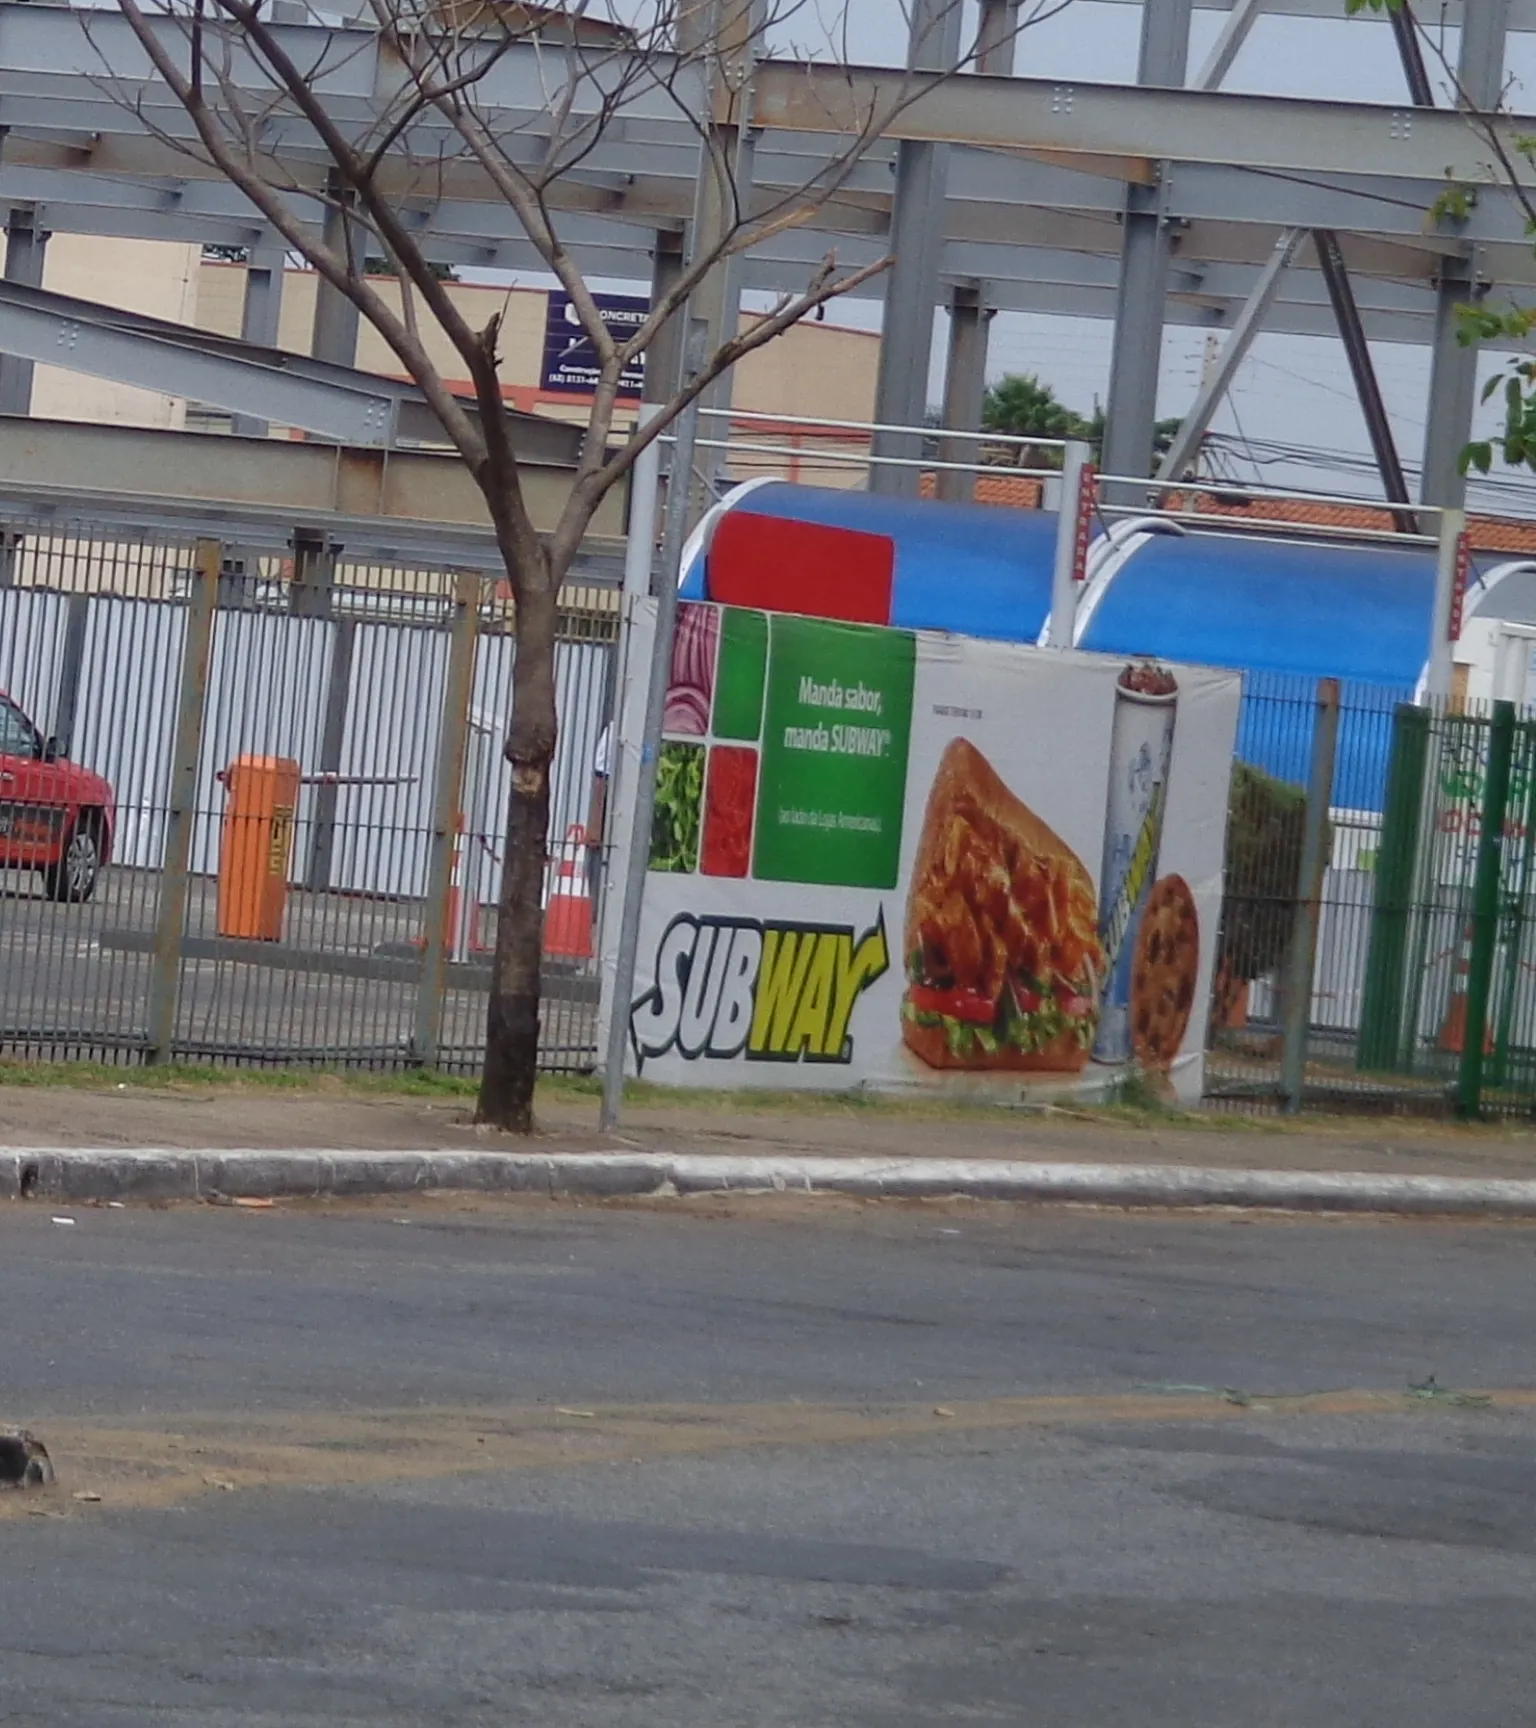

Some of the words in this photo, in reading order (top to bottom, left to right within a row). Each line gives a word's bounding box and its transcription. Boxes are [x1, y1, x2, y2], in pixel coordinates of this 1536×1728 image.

[798, 675, 843, 709] Manda
[844, 680, 883, 717] sabor,
[783, 720, 829, 752] manda
[631, 901, 890, 1077] SUBWAY
